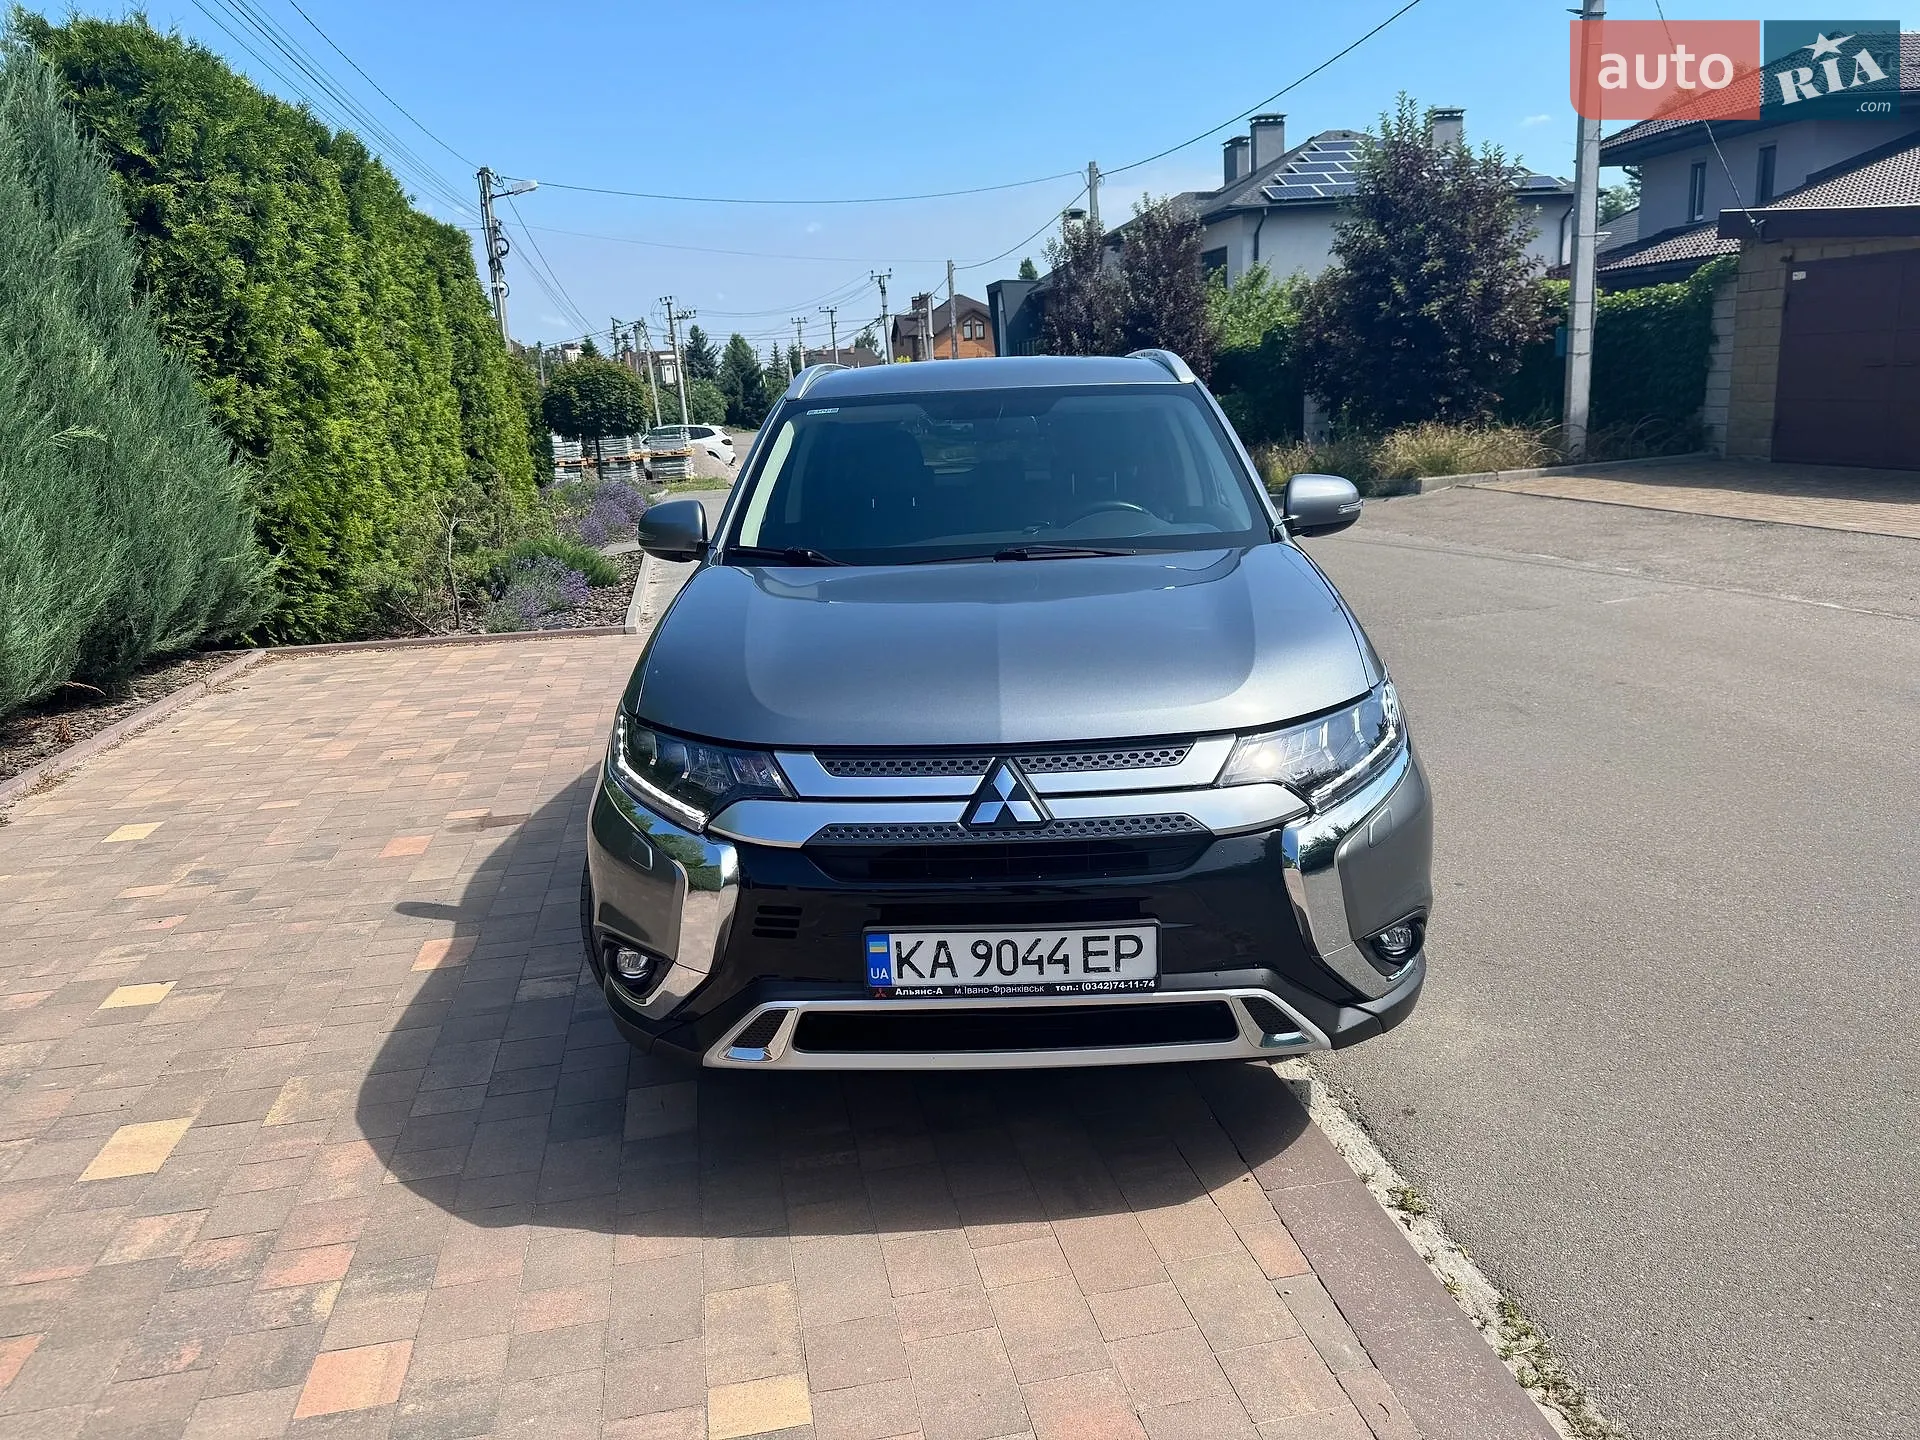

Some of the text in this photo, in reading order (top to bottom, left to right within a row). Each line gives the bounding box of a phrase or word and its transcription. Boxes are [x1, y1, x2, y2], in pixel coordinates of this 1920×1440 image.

[895, 935, 1144, 979] KA 9044 EP
[870, 967, 889, 980] UA
[895, 987, 944, 996] Альянс-А
[1081, 980, 1156, 992] (0342)74-11-74
